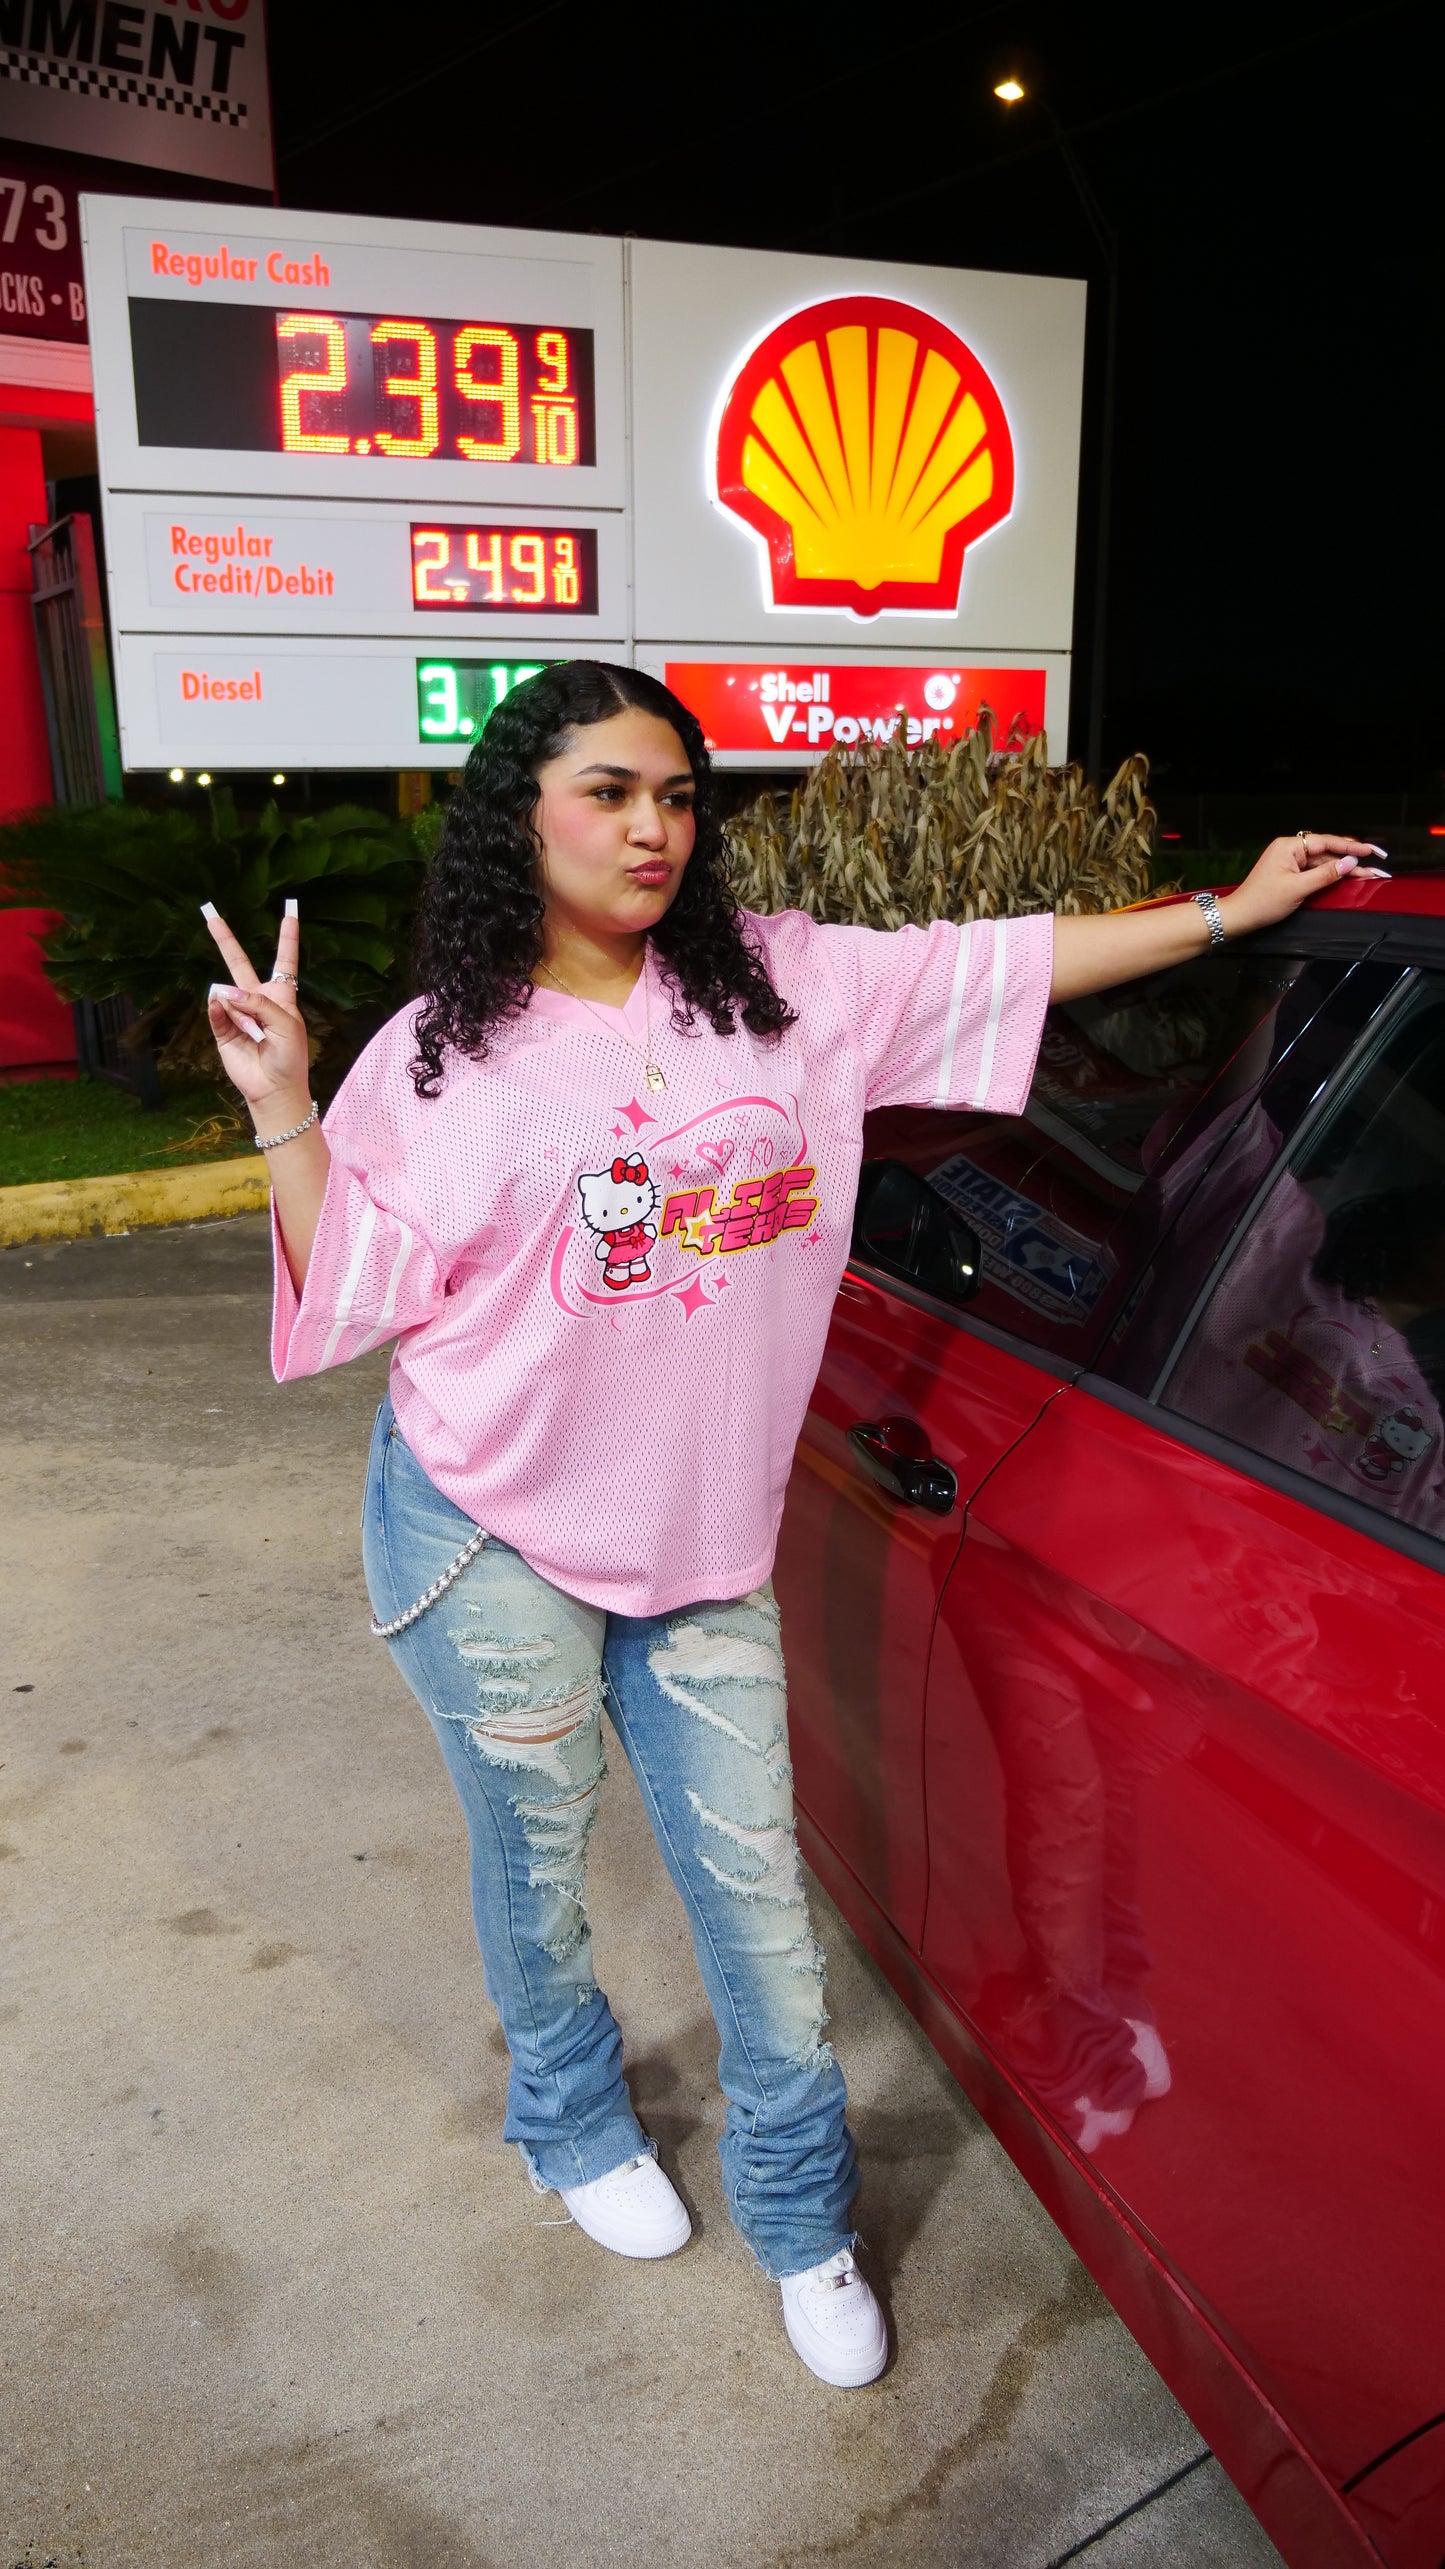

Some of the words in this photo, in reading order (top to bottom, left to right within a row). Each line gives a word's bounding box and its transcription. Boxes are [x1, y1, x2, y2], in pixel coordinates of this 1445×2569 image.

[151, 242, 258, 286] Regular
[266, 251, 331, 288] Cash
[277, 315, 522, 464] 2.39
[170, 527, 274, 564] Regular
[413, 530, 547, 604] 2.49
[174, 564, 335, 597] Credit/Debit
[181, 671, 263, 702] Diesel
[419, 665, 546, 736] 3.1
[760, 671, 831, 703] Shell
[760, 705, 942, 746] V-Power
[660, 1167, 817, 1236] ALIEF
[698, 1198, 819, 1256] TEXAS
